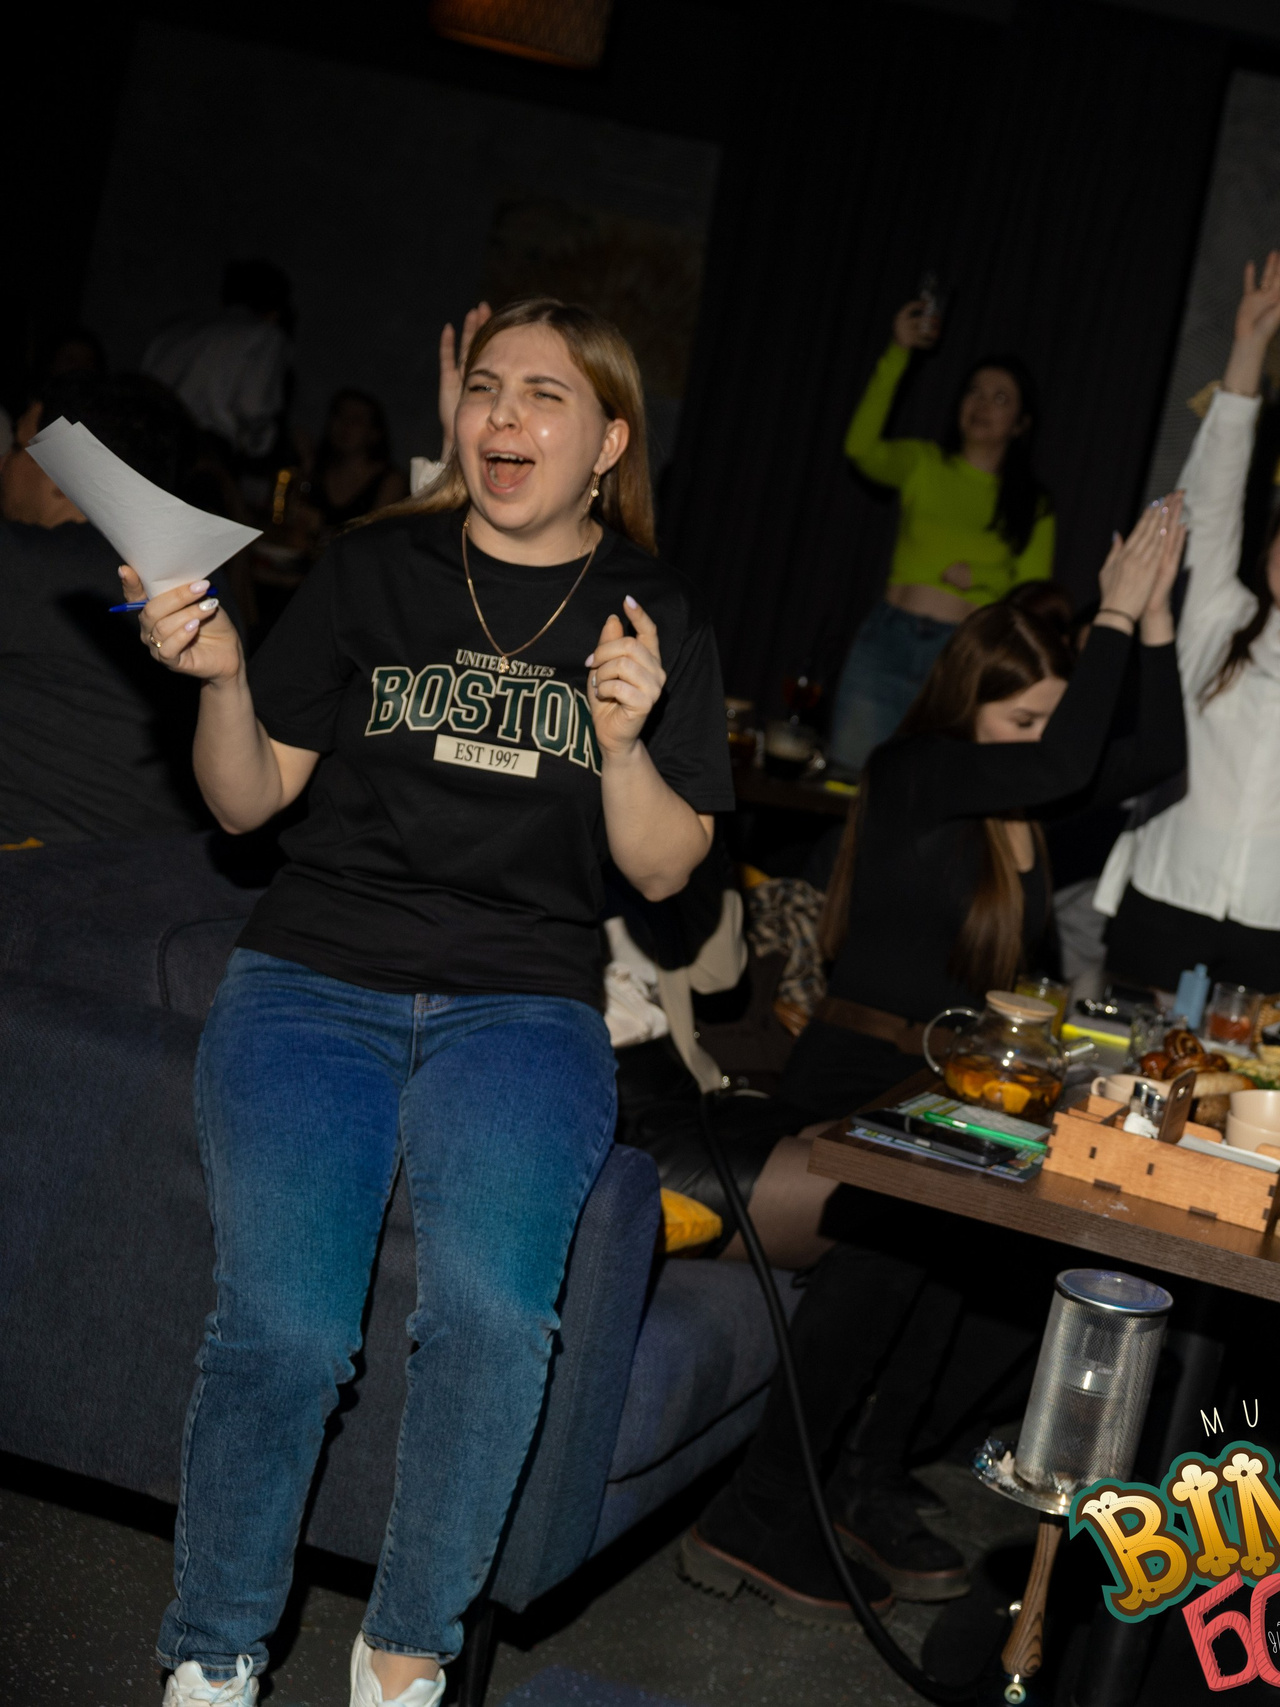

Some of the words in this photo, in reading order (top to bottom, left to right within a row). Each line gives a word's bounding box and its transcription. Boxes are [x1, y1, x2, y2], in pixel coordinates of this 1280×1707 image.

[508, 659, 556, 677] STATES
[454, 742, 485, 764] EST
[488, 748, 520, 771] 1997
